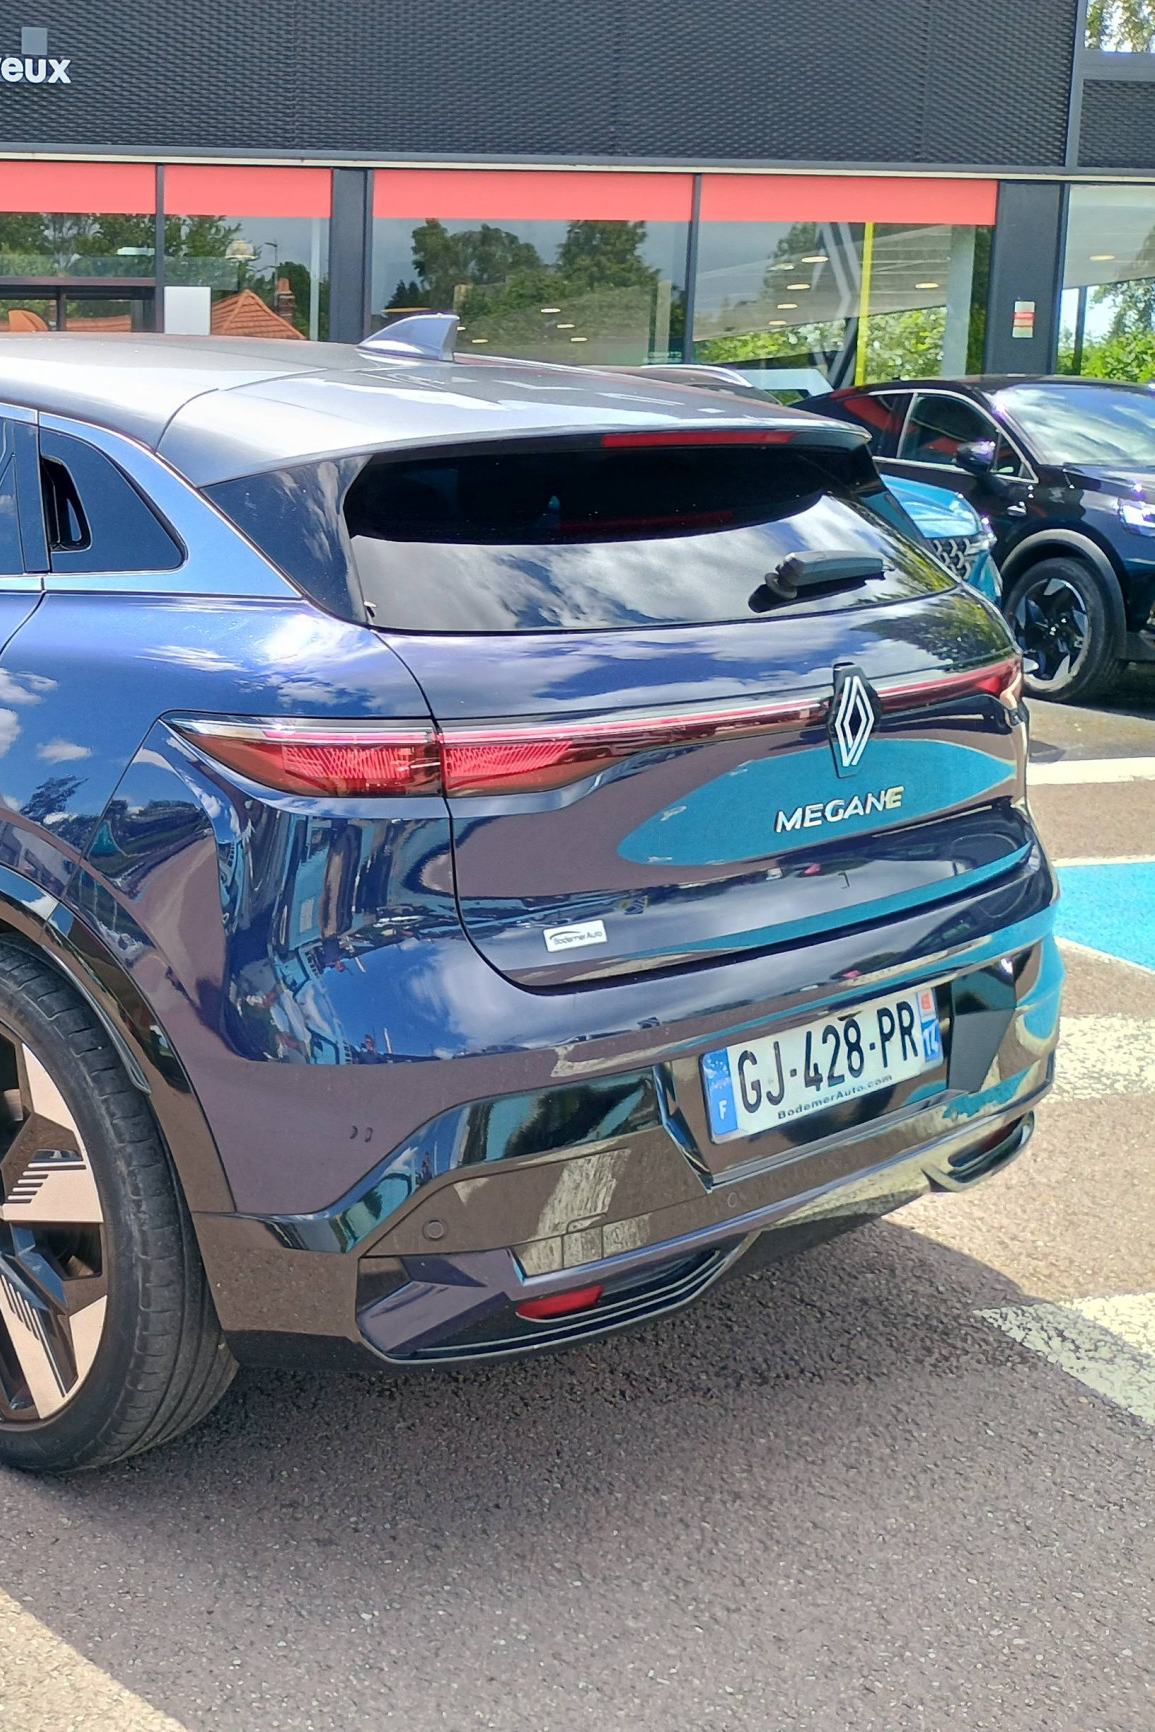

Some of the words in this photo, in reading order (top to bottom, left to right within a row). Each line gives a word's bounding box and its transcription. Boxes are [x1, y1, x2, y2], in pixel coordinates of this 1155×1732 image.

[775, 785, 905, 833] MEGANE
[737, 1001, 919, 1114] GJ-428-PR
[718, 1099, 728, 1121] F
[777, 1074, 893, 1120] BodemerAuto.com
